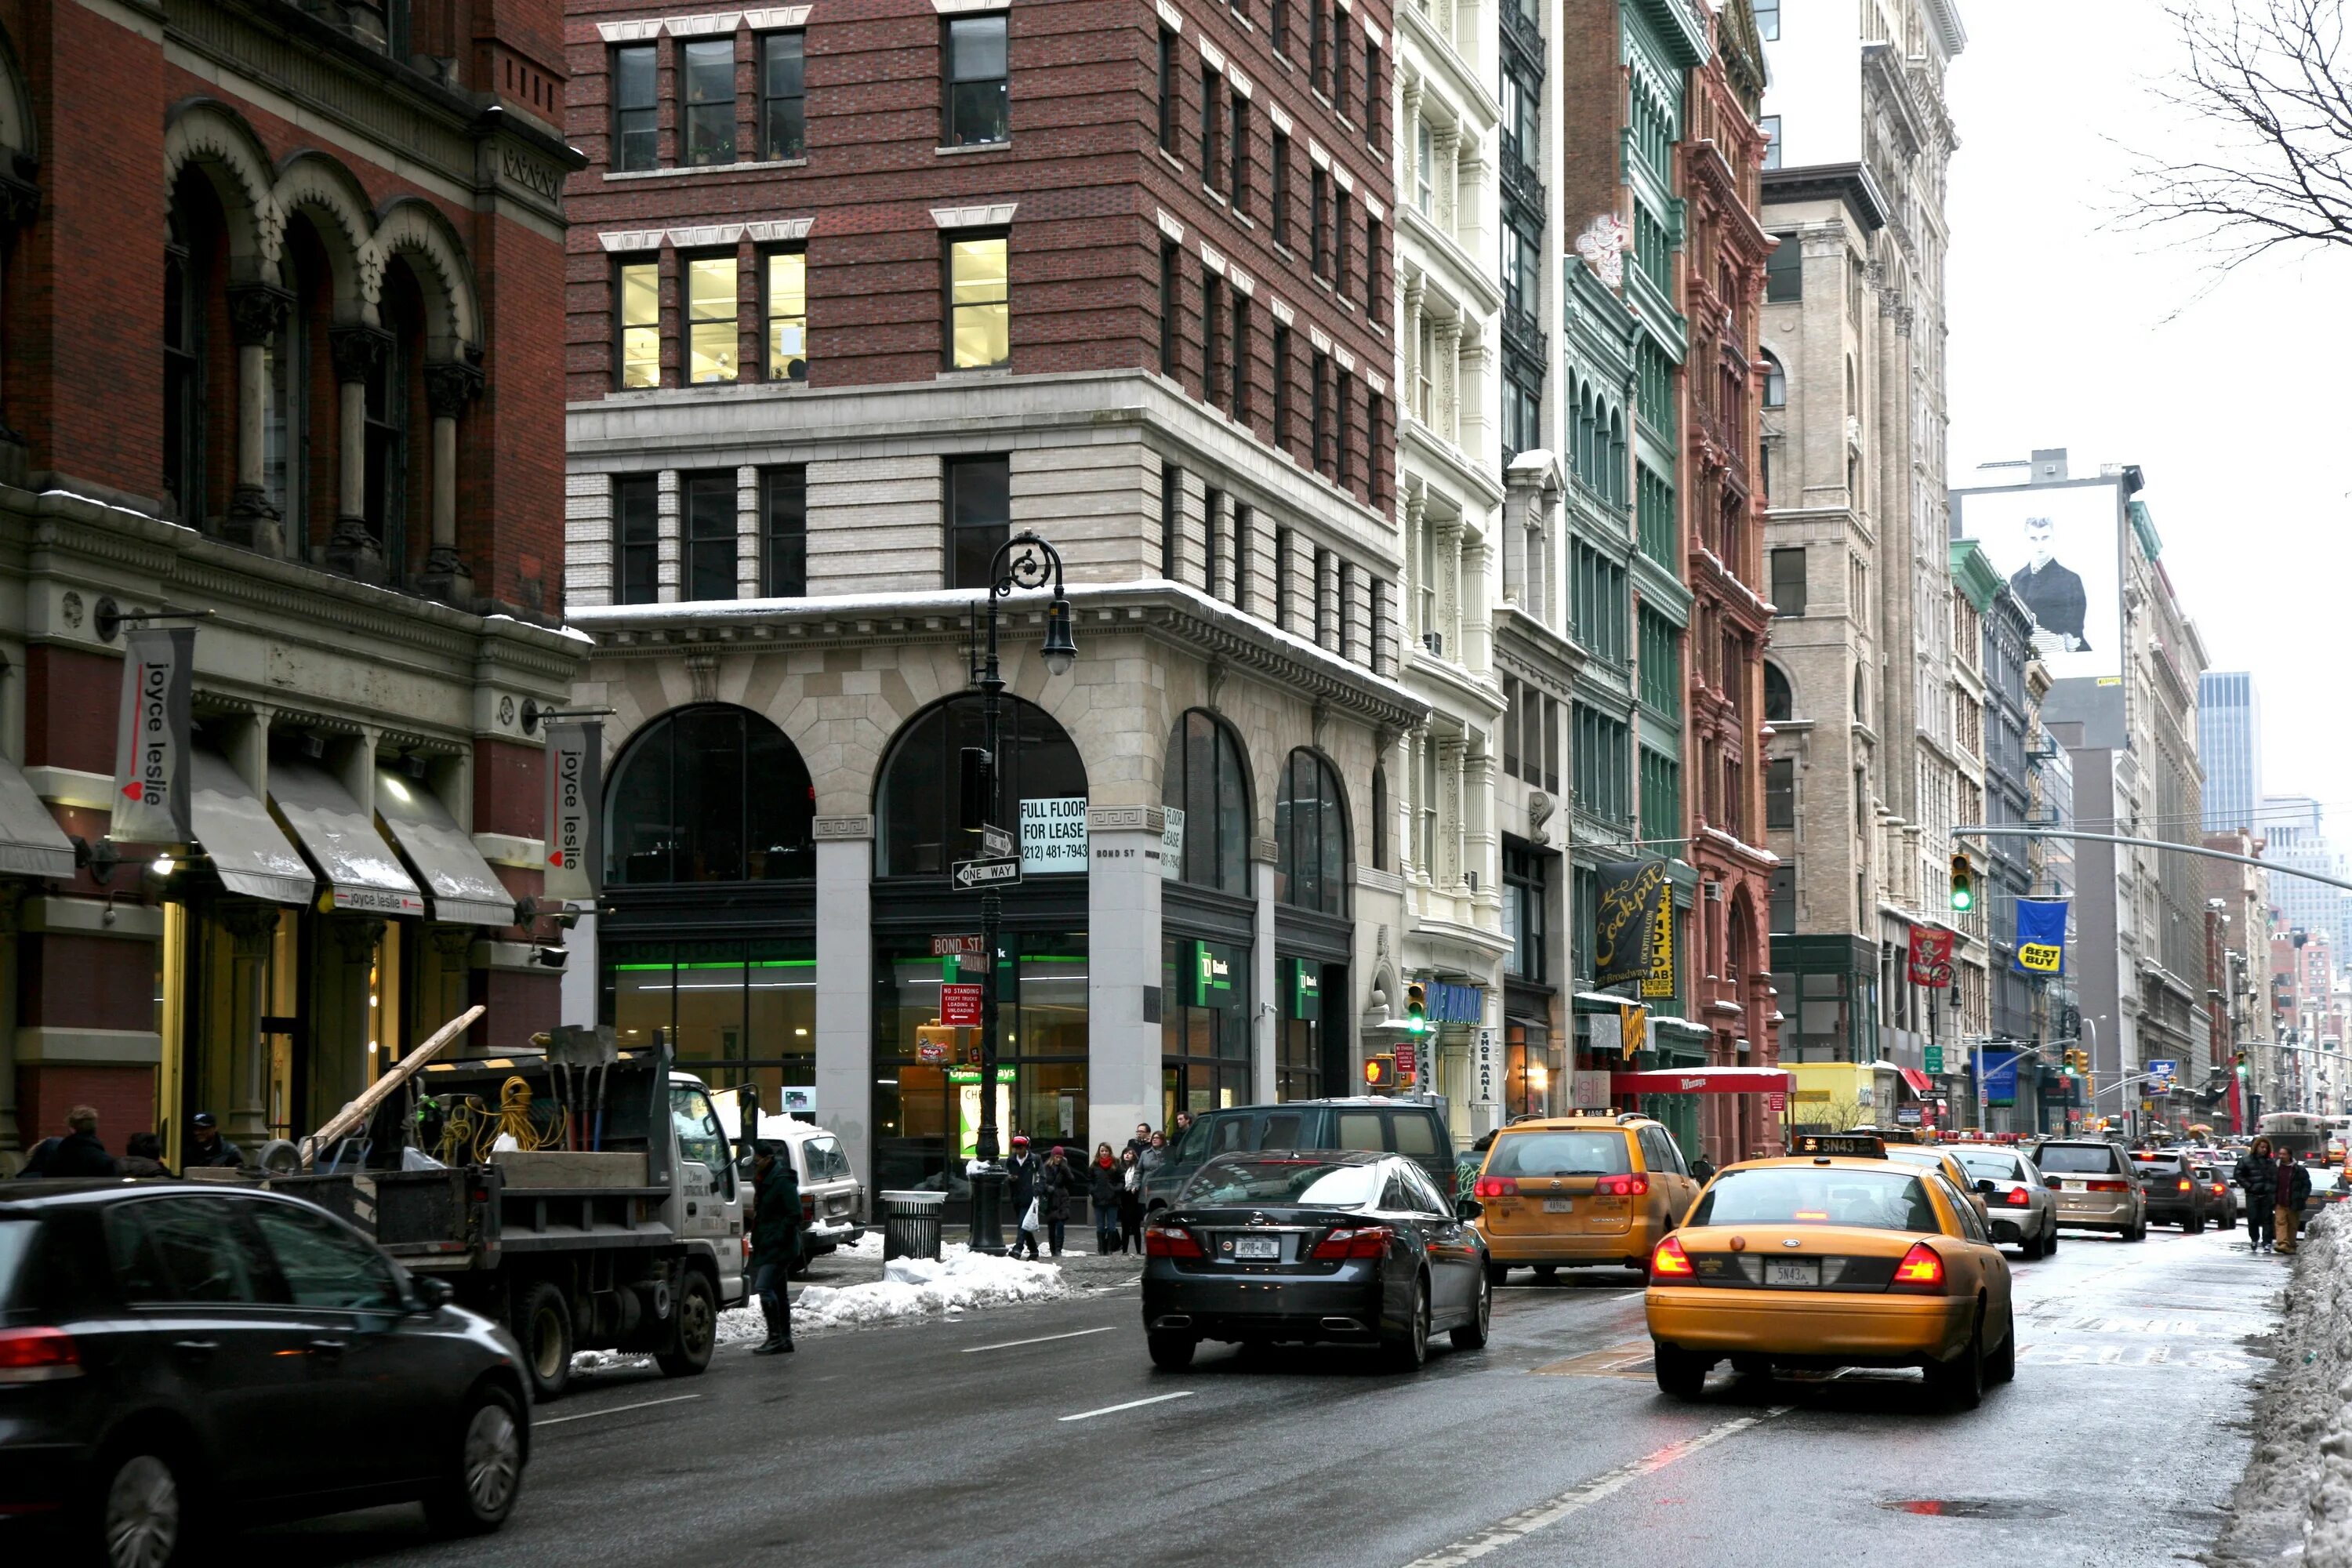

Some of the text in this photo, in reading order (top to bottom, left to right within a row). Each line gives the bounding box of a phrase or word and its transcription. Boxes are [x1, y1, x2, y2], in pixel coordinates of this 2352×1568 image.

[144, 662, 169, 805] joyce leslie
[561, 750, 581, 869] joyce leslie
[1020, 800, 1086, 818] FULL FLOOR
[1167, 808, 1182, 827] FLOOR
[1024, 822, 1083, 839] FOR LEASE
[988, 835, 1010, 851] ONE WAY
[1163, 831, 1179, 848] LEASE
[1022, 844, 1087, 862] (212) 481-7943
[963, 866, 1011, 880] ONE WAY
[350, 890, 400, 908] joyce leslie
[1595, 860, 1666, 966] Cockpit
[935, 938, 961, 954] BOND
[967, 937, 979, 952] ST
[2025, 946, 2058, 956] BEST
[1202, 958, 1228, 977] TD Bank
[2025, 955, 2054, 966] BUY
[1306, 975, 1317, 986] Bank
[1607, 969, 1648, 982] Broadway
[1653, 971, 1668, 979] AB
[997, 1069, 1015, 1079] ays
[1479, 1032, 1490, 1101] SHOE MANIA
[1823, 1139, 1854, 1152] 5N43
